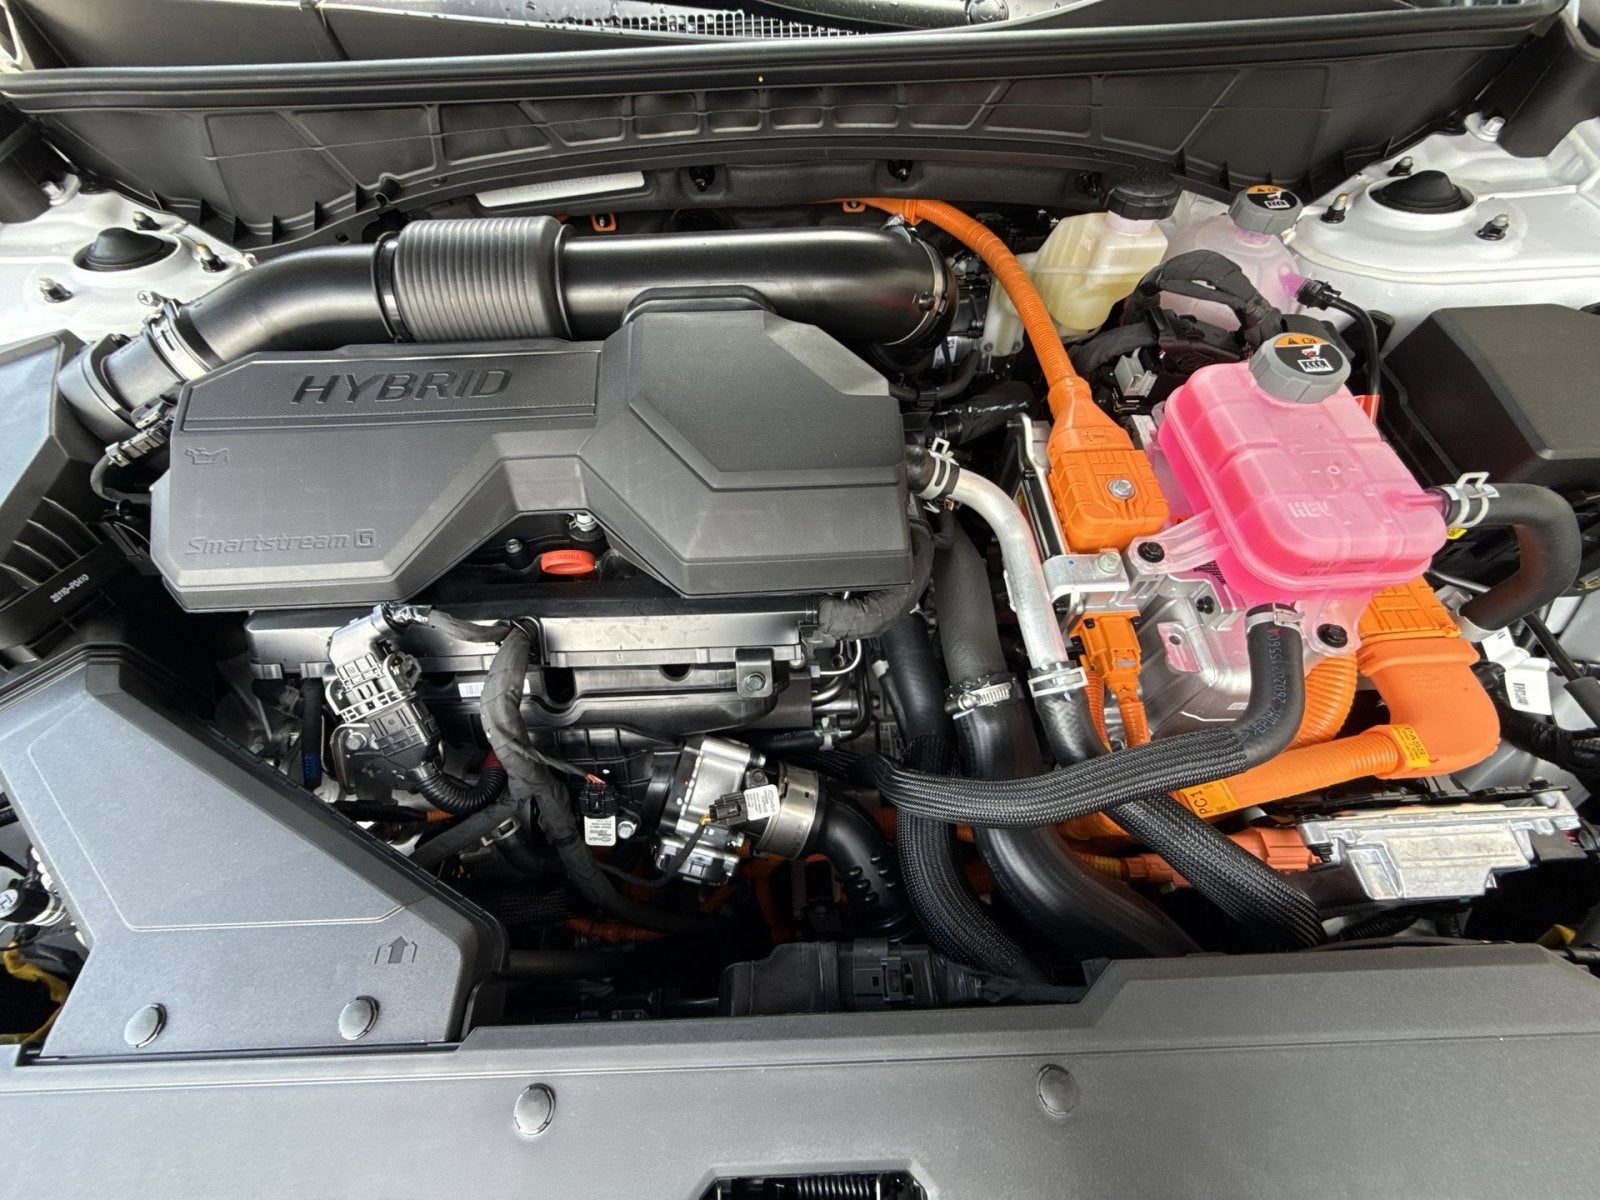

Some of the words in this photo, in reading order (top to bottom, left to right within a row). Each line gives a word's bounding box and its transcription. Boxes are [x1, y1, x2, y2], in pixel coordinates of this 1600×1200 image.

[290, 368, 513, 404] HYBRID
[184, 534, 350, 556] Smartstream
[355, 529, 376, 549] G
